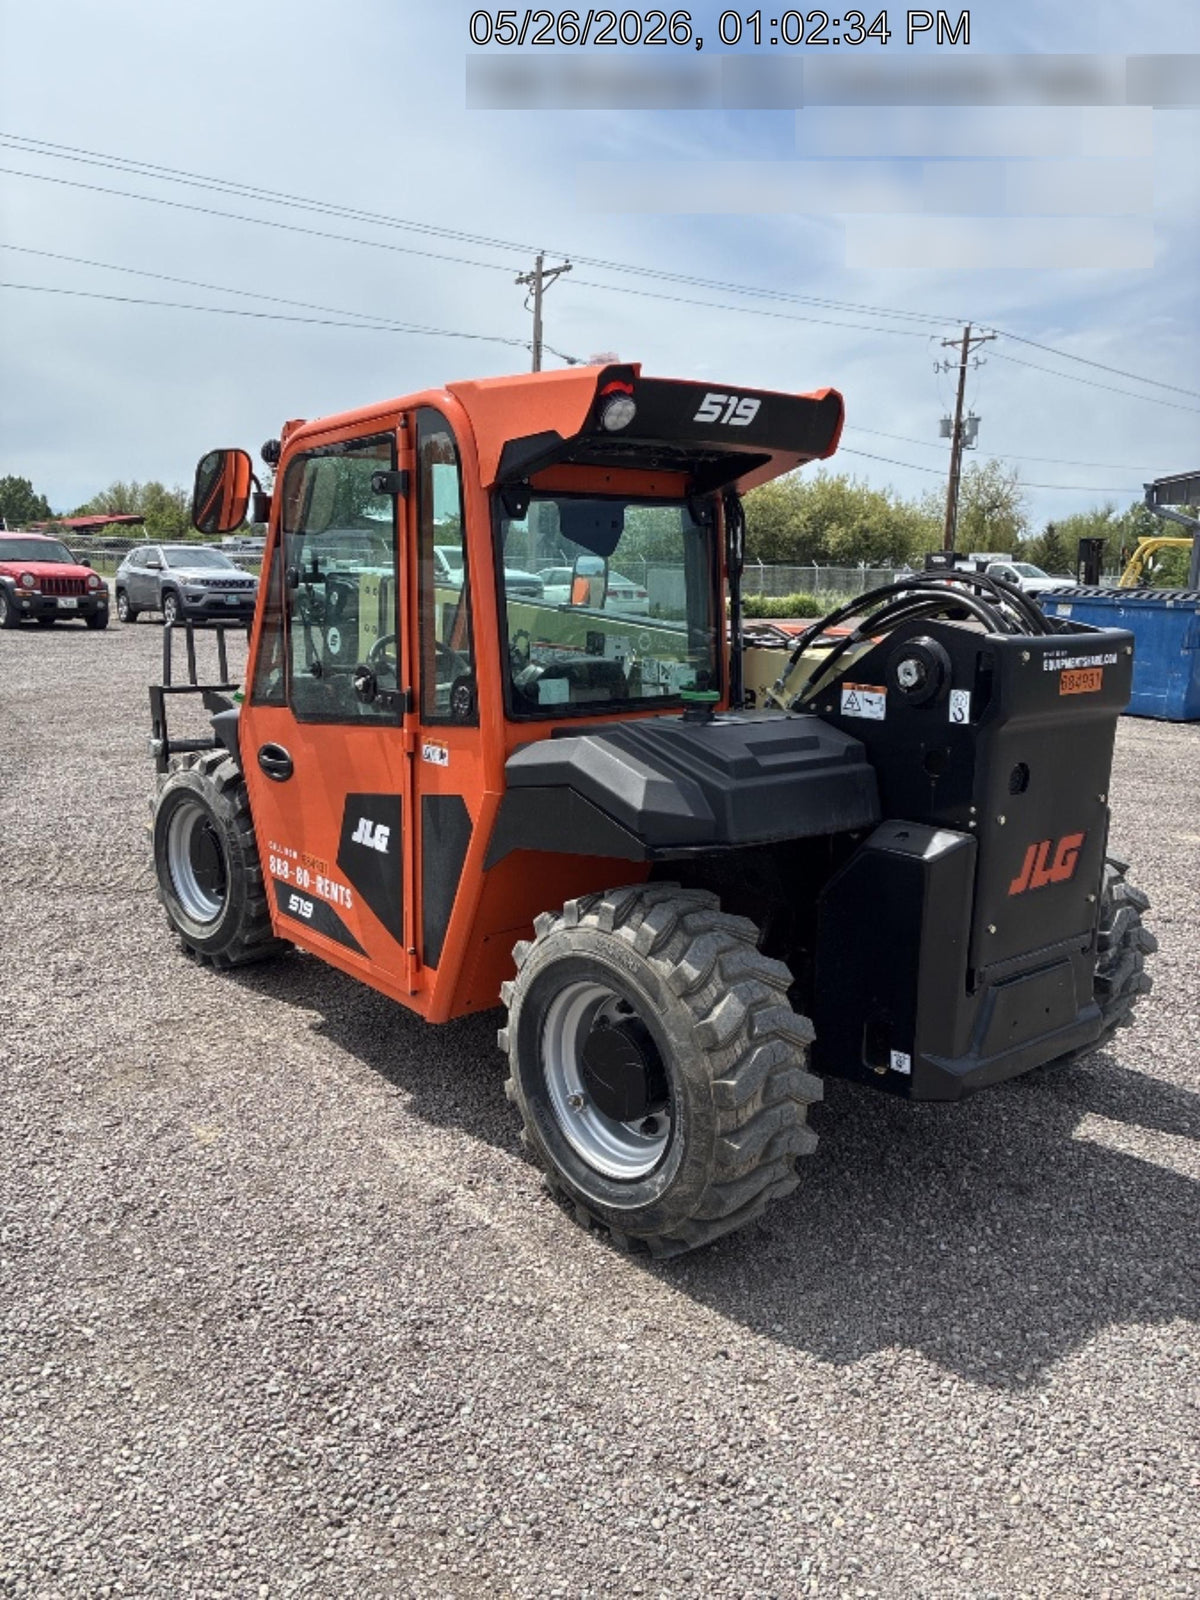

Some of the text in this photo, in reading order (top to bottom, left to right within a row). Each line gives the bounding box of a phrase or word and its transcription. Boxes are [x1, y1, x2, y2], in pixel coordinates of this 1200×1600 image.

[693, 392, 762, 426] 519
[352, 817, 390, 853] JLG
[1008, 832, 1085, 896] JLG
[288, 893, 314, 919] 519
